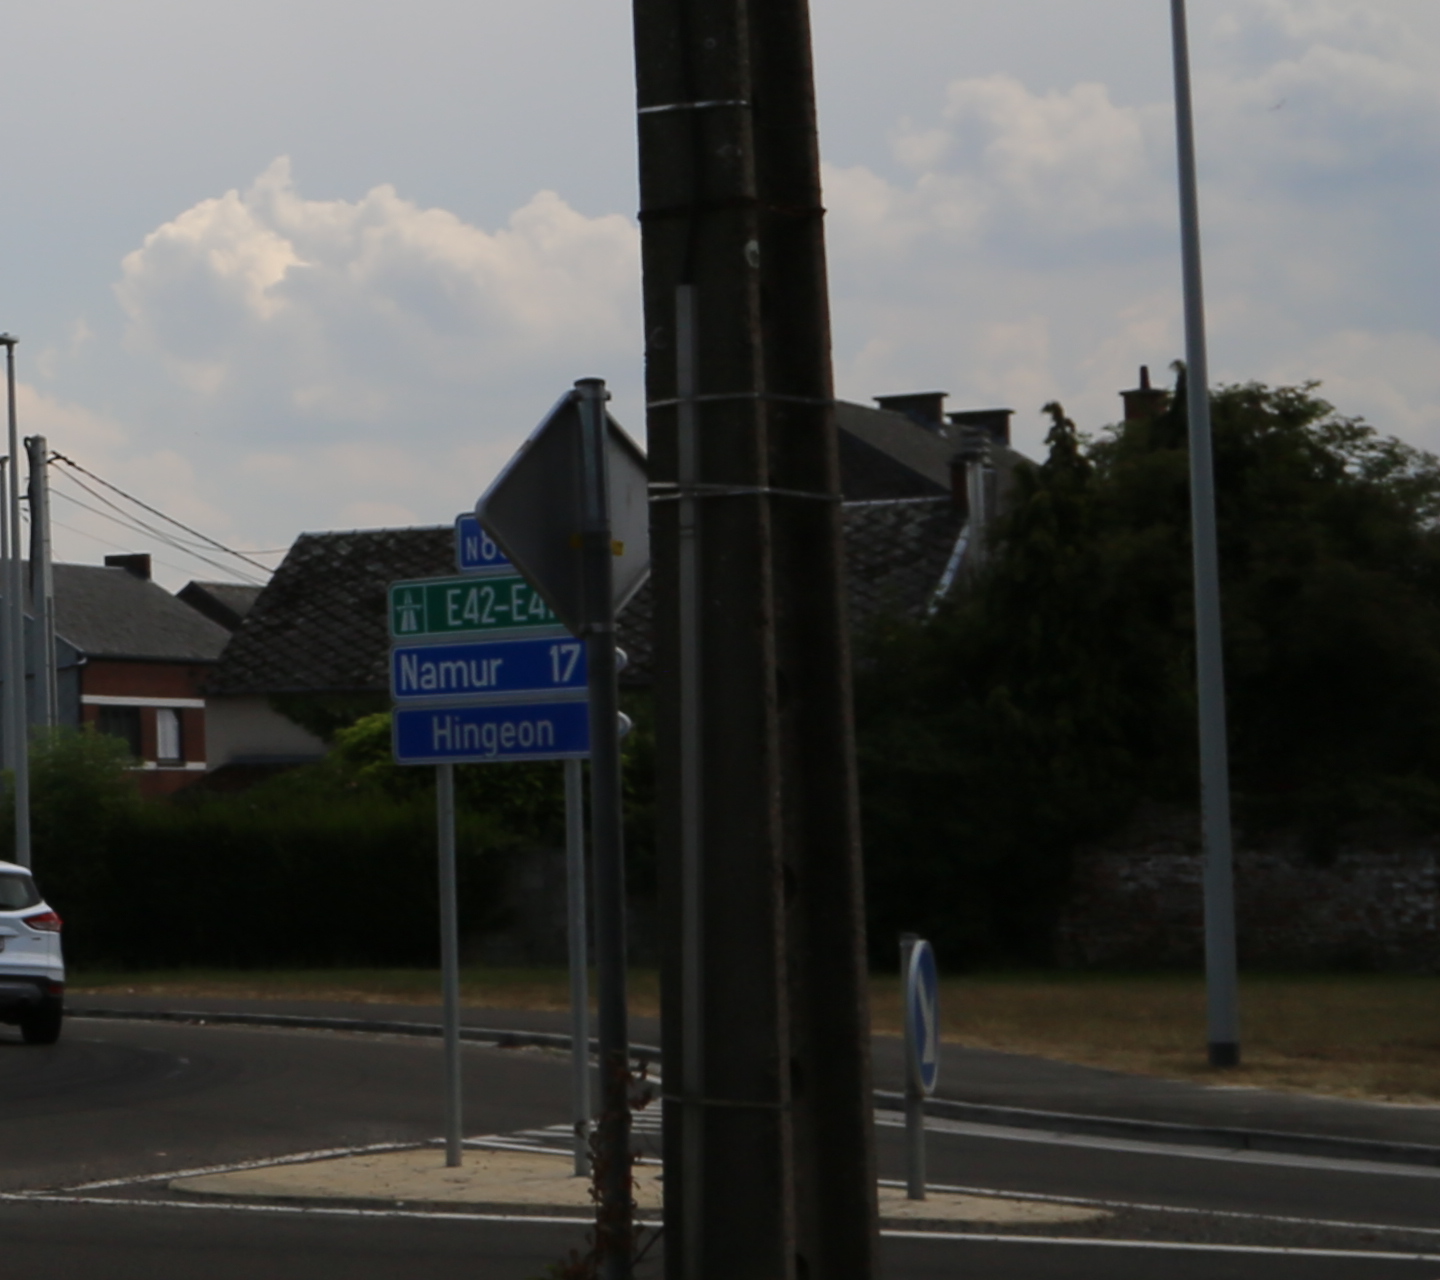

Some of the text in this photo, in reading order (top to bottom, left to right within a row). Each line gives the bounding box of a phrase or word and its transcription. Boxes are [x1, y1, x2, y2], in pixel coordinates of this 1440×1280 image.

[399, 643, 583, 691] Namur 17
[431, 715, 555, 757] Hingeon
